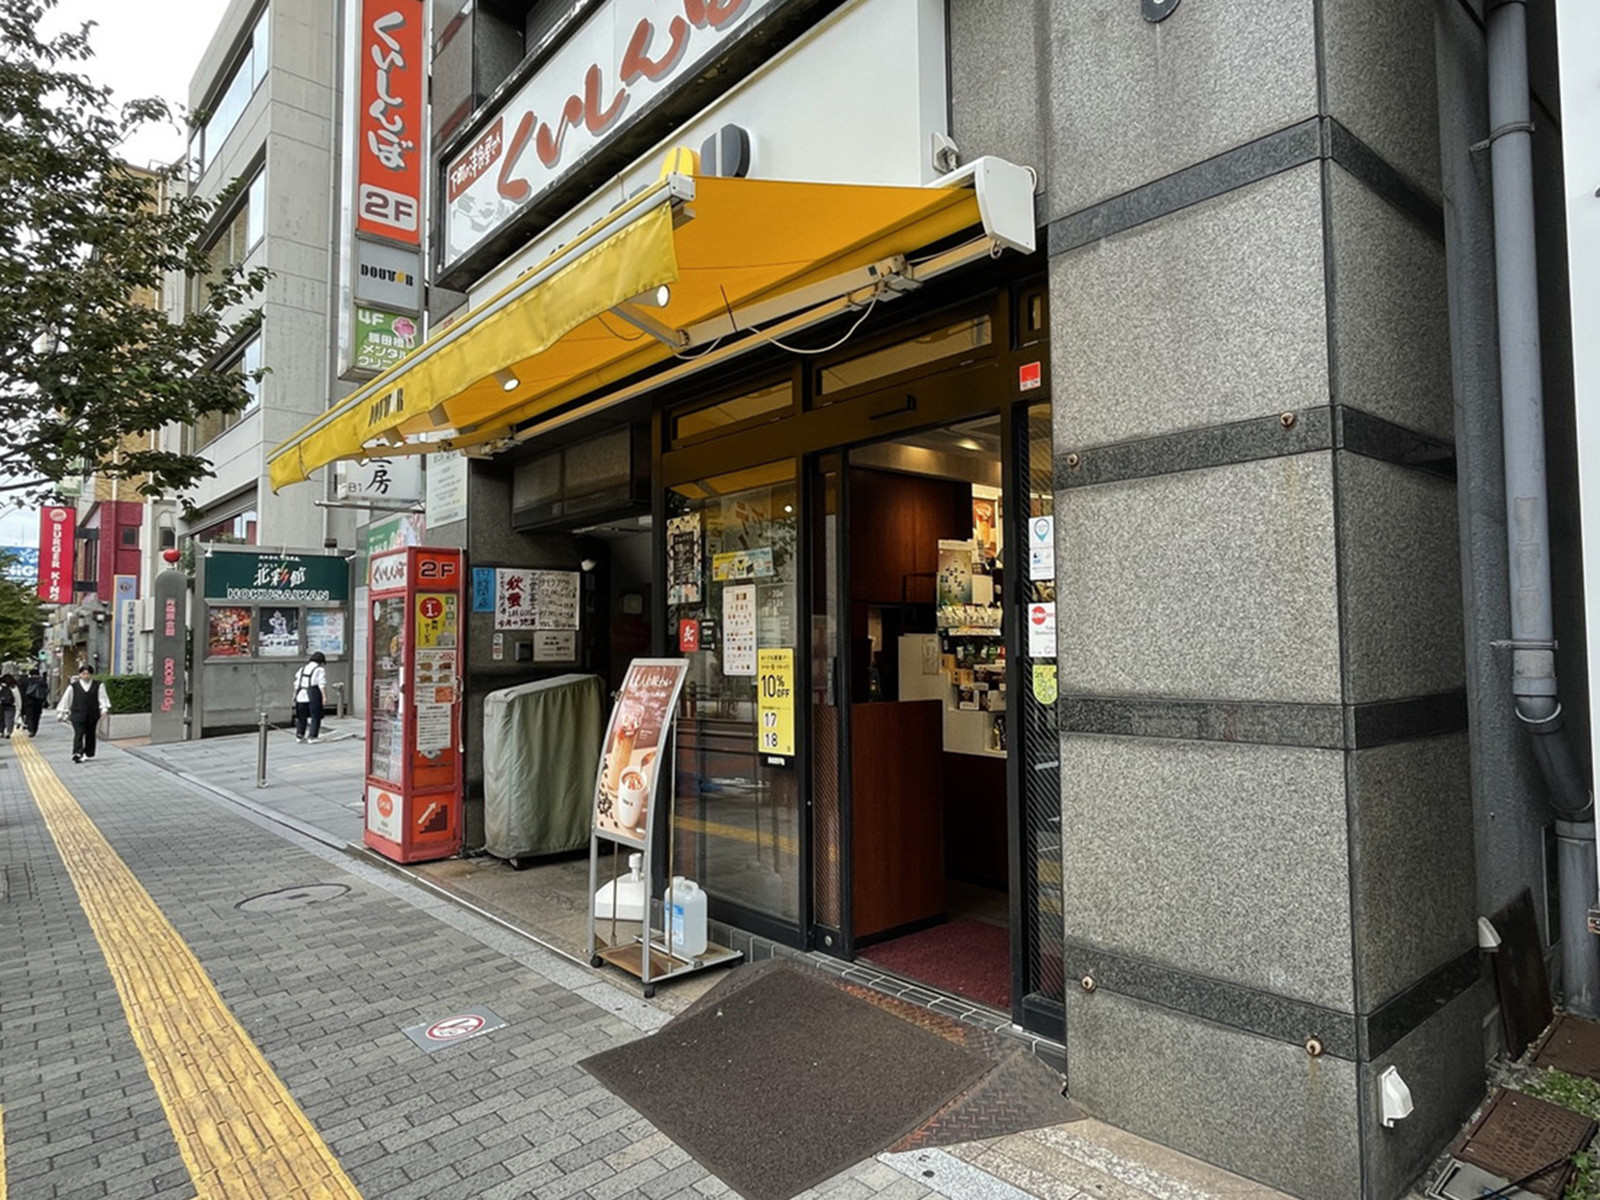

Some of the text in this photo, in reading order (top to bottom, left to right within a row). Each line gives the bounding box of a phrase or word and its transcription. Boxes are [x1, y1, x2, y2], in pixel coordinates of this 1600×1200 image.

[364, 190, 413, 222] 2F
[361, 263, 414, 287] DOUTOR
[358, 309, 384, 326] 4F
[348, 482, 363, 493] B1
[49, 523, 62, 601] BURGER KING
[420, 560, 455, 579] 2F
[226, 587, 330, 600] HOKUSAIKAN
[776, 688, 790, 698] OFF
[764, 712, 777, 727] 17
[764, 732, 779, 748] 18
